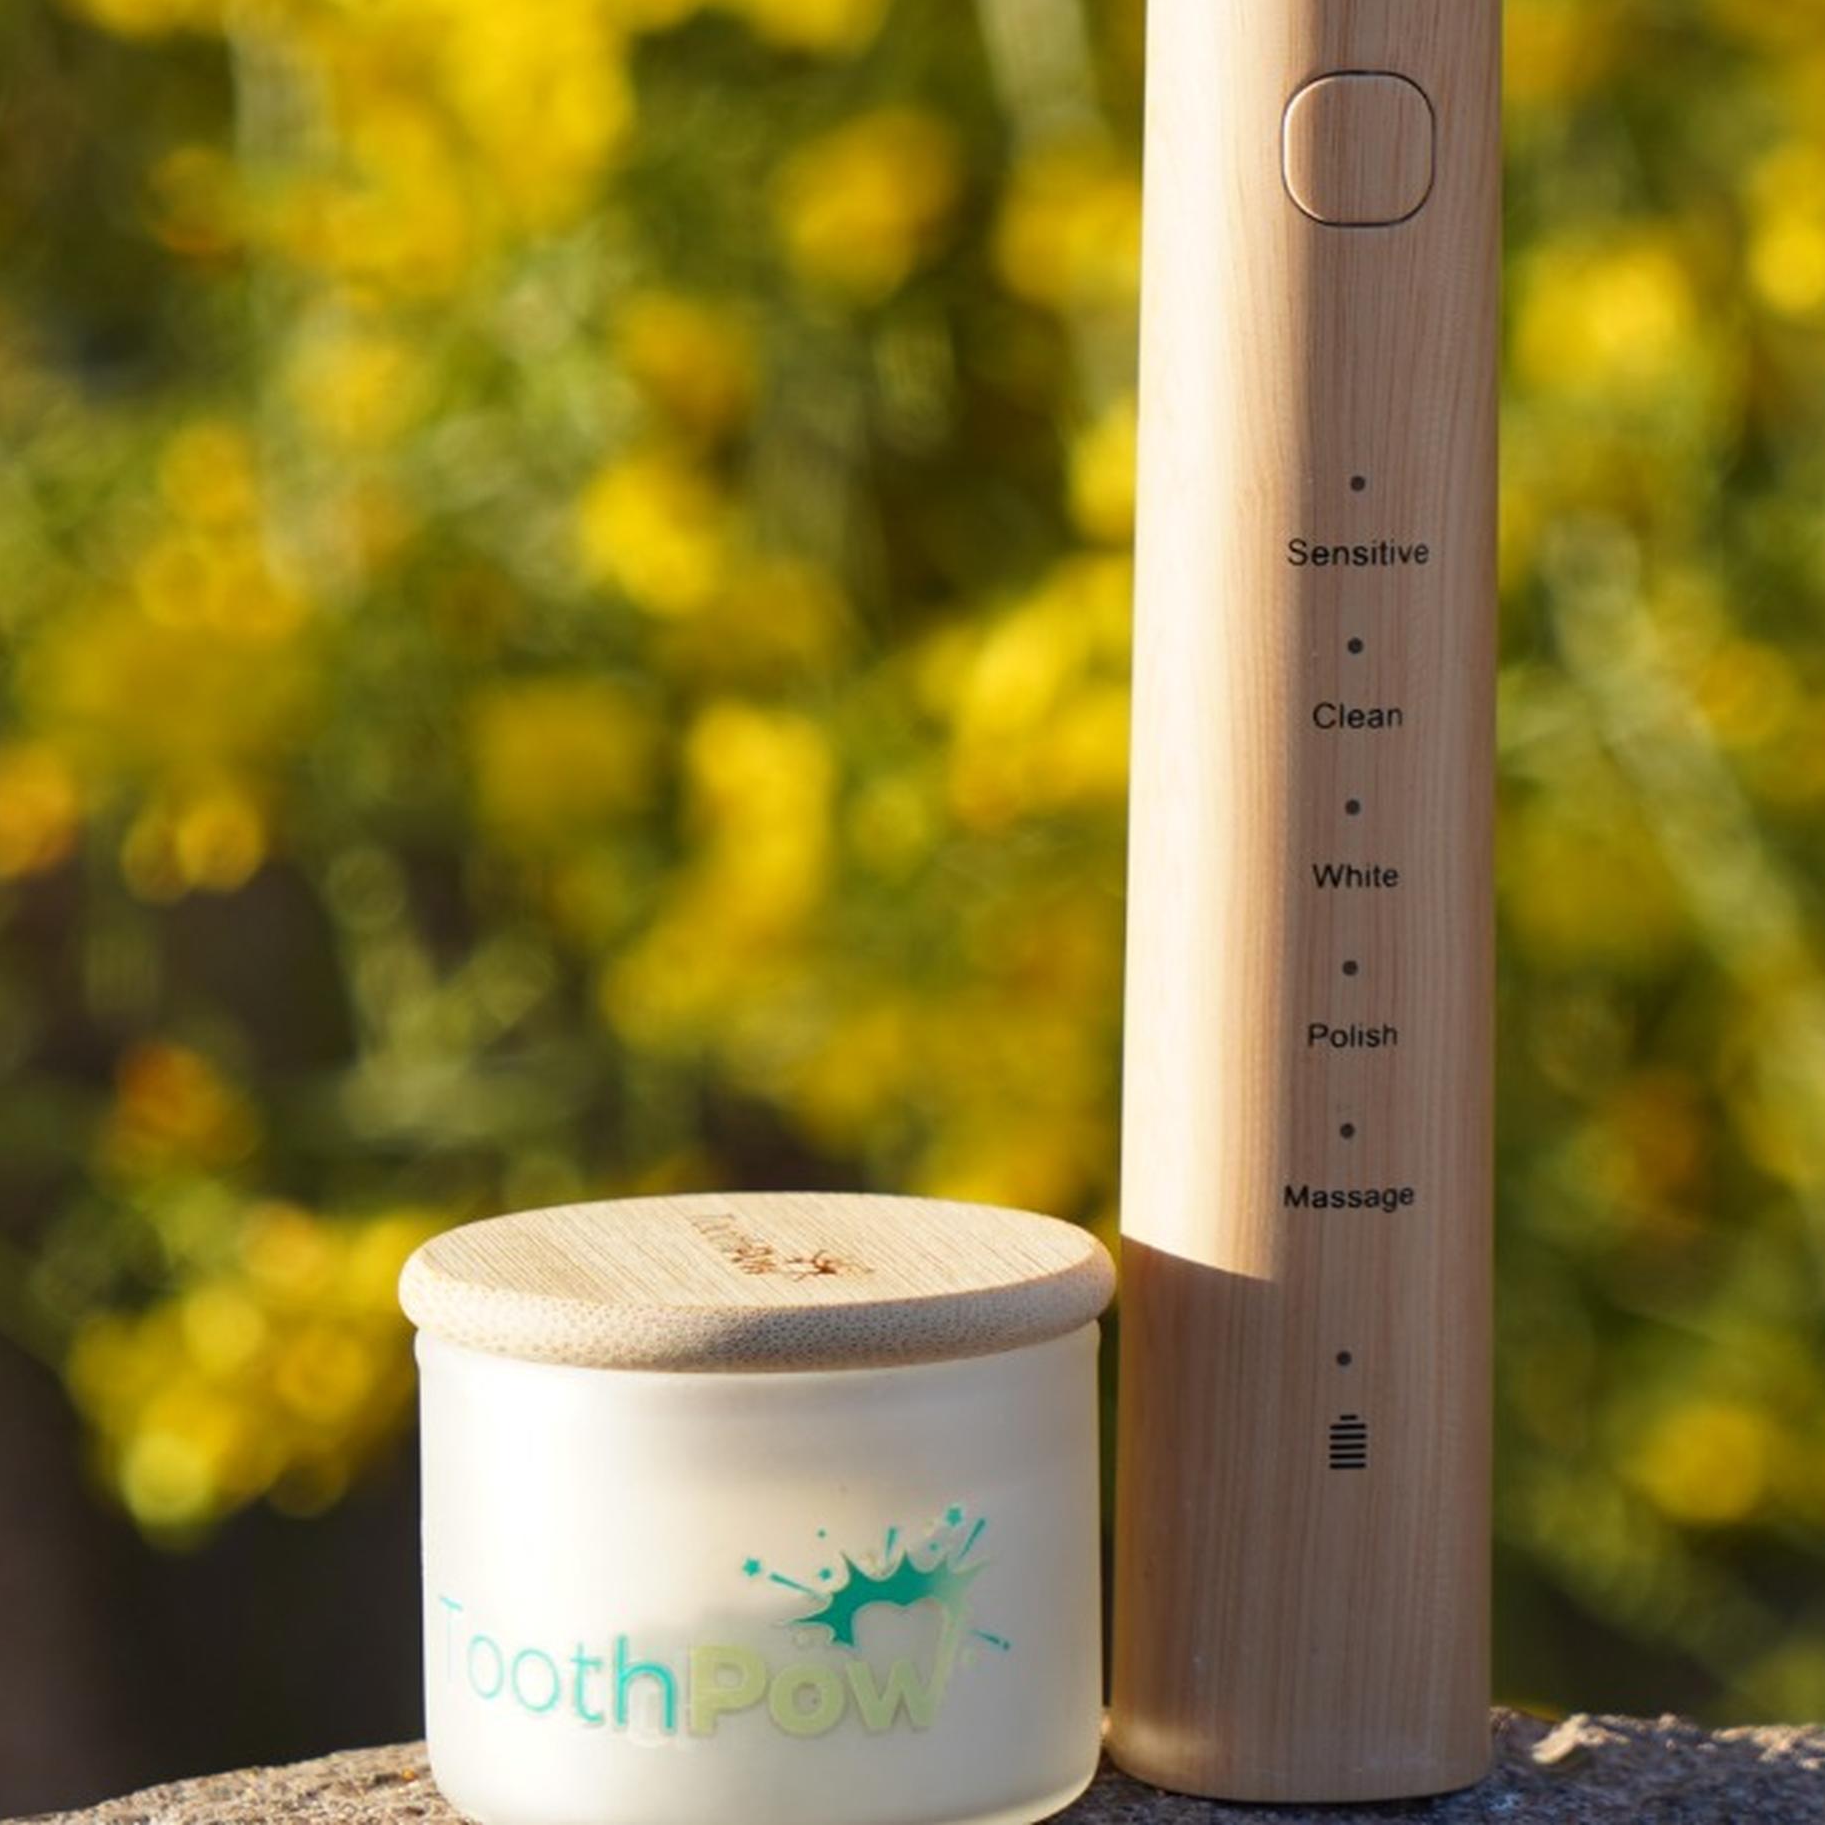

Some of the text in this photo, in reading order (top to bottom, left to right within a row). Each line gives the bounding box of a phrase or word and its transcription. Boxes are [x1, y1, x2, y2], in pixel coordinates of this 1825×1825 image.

[1287, 538, 1430, 567] Sensitive
[1312, 702, 1404, 730] Clean
[1312, 863, 1400, 889] White
[1307, 1023, 1399, 1049] Polish
[1283, 1184, 1415, 1213] Massage
